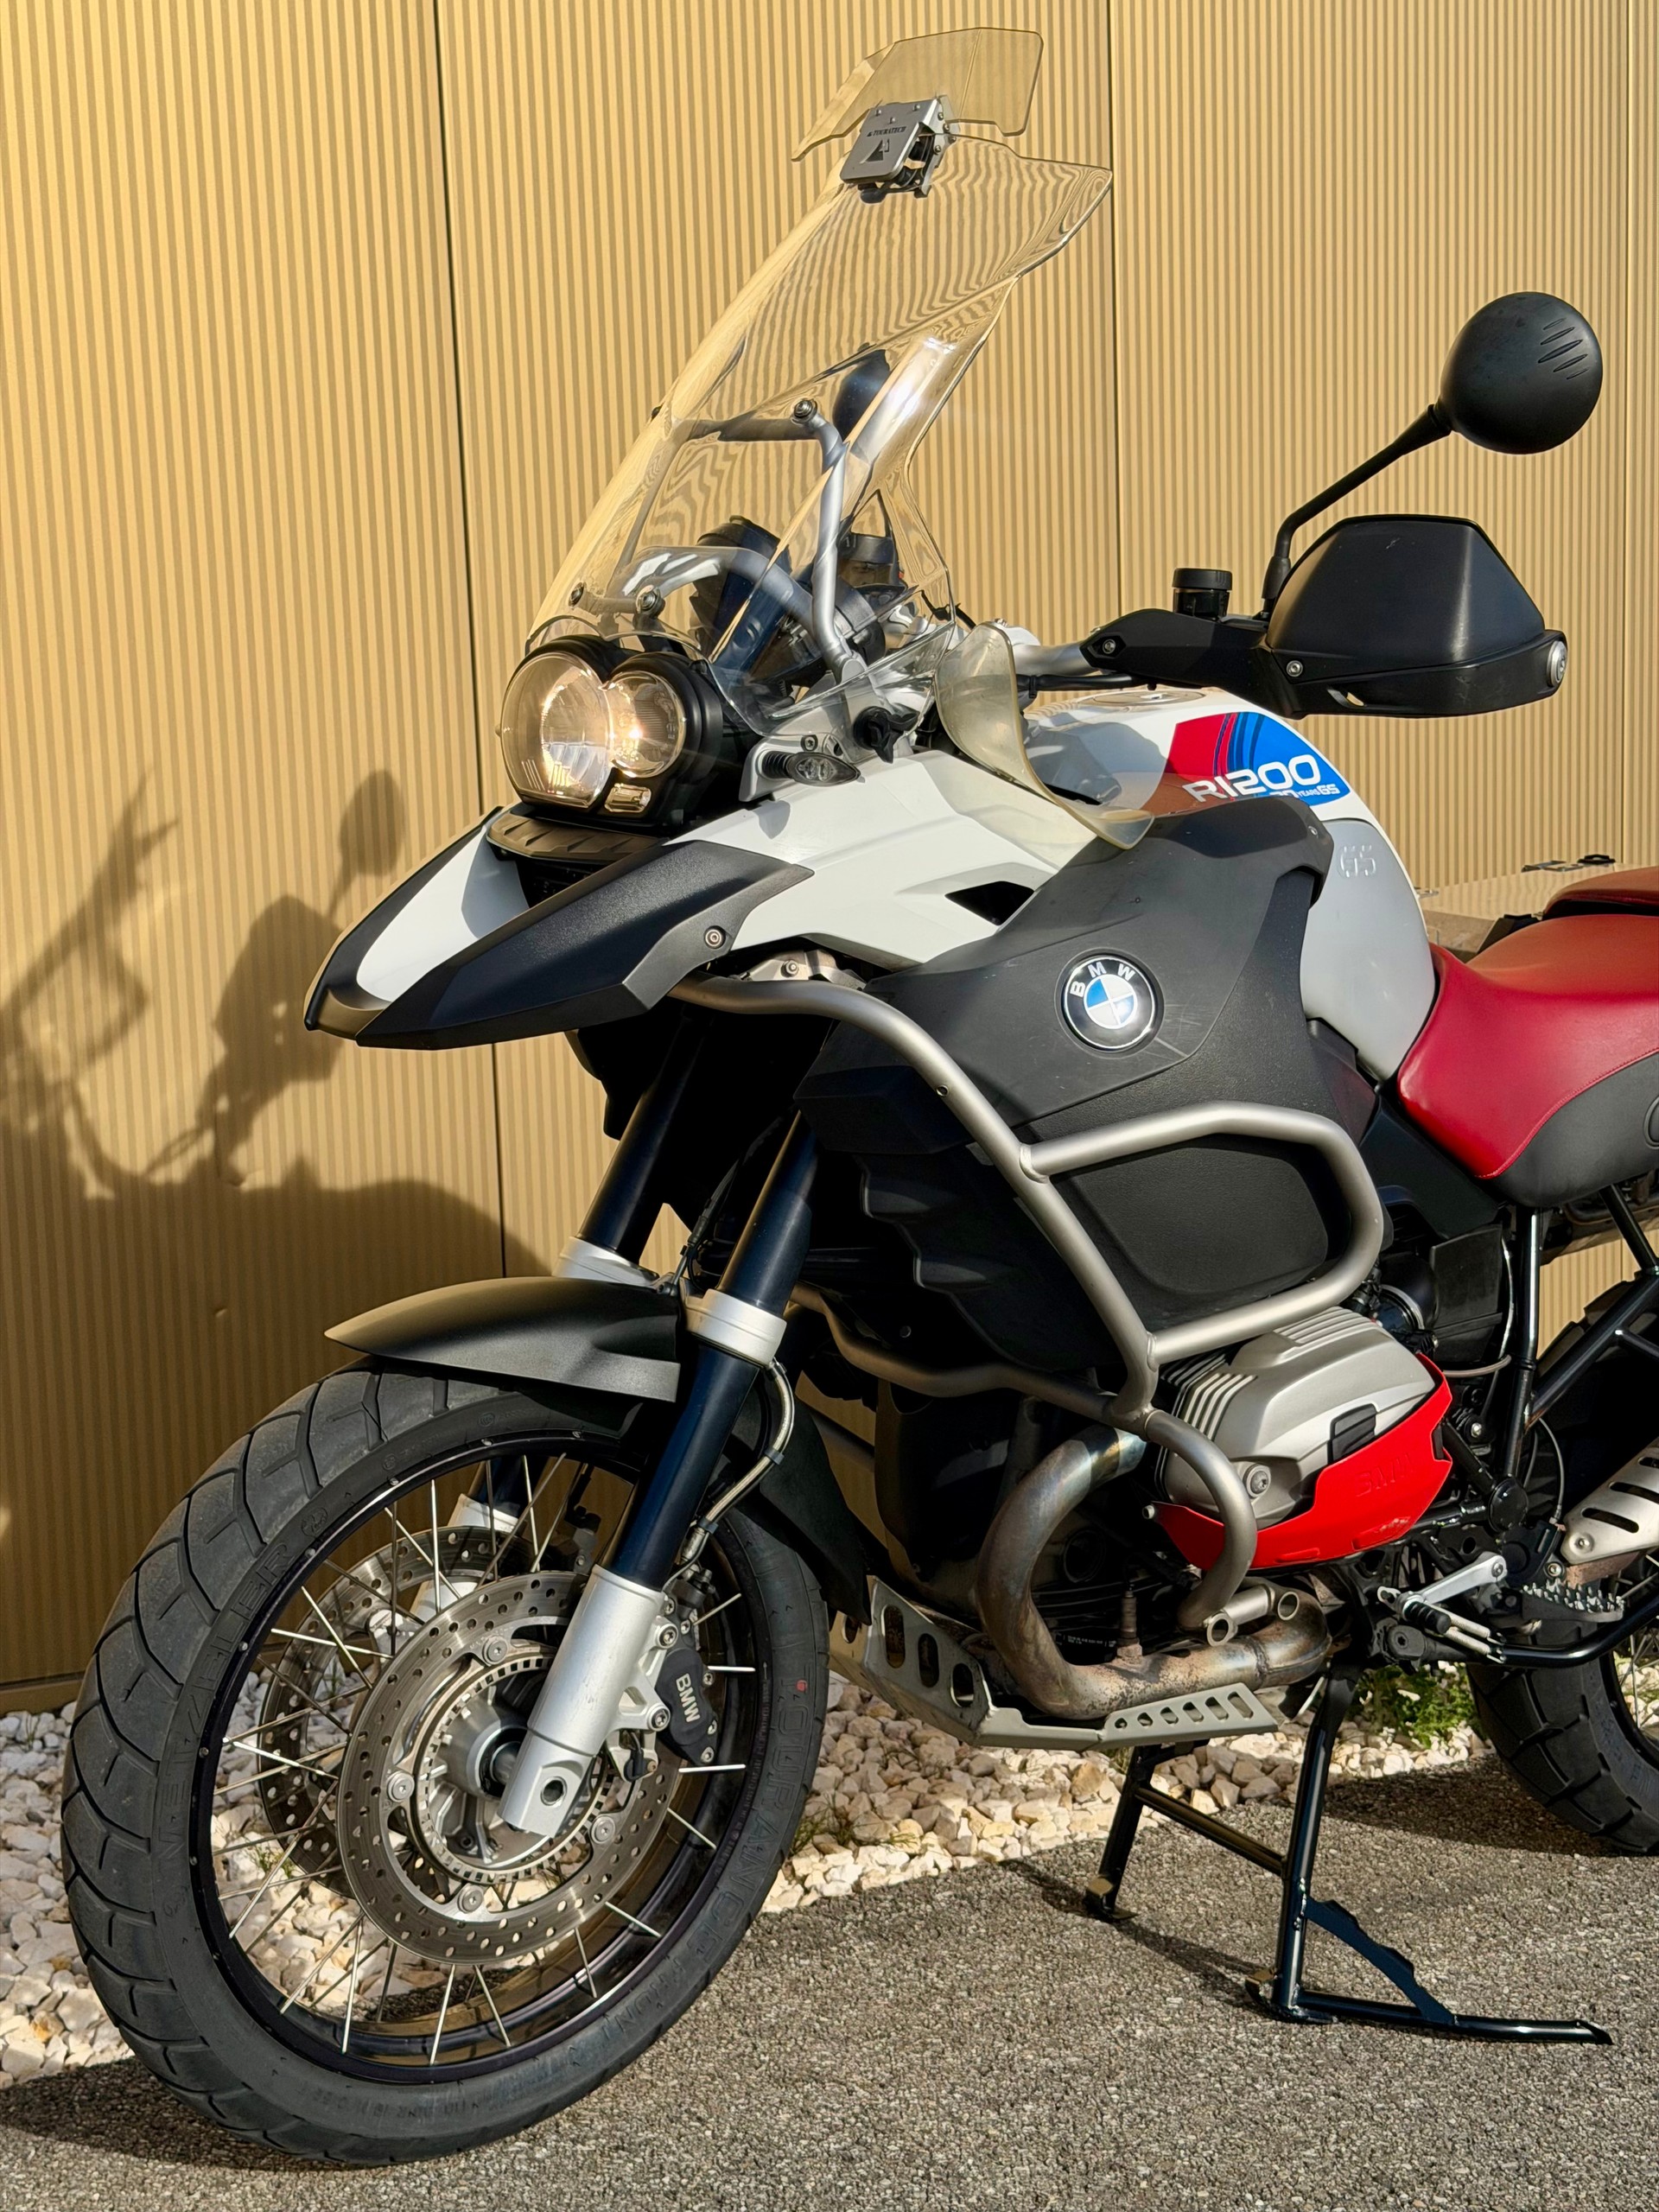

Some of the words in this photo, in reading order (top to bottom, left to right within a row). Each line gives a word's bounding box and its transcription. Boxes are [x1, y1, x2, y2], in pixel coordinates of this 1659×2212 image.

[1319, 784, 1340, 795] GS
[1070, 961, 1135, 997] BMW
[676, 1673, 701, 1723] BMW
[688, 1664, 810, 1964] TOURANCE
